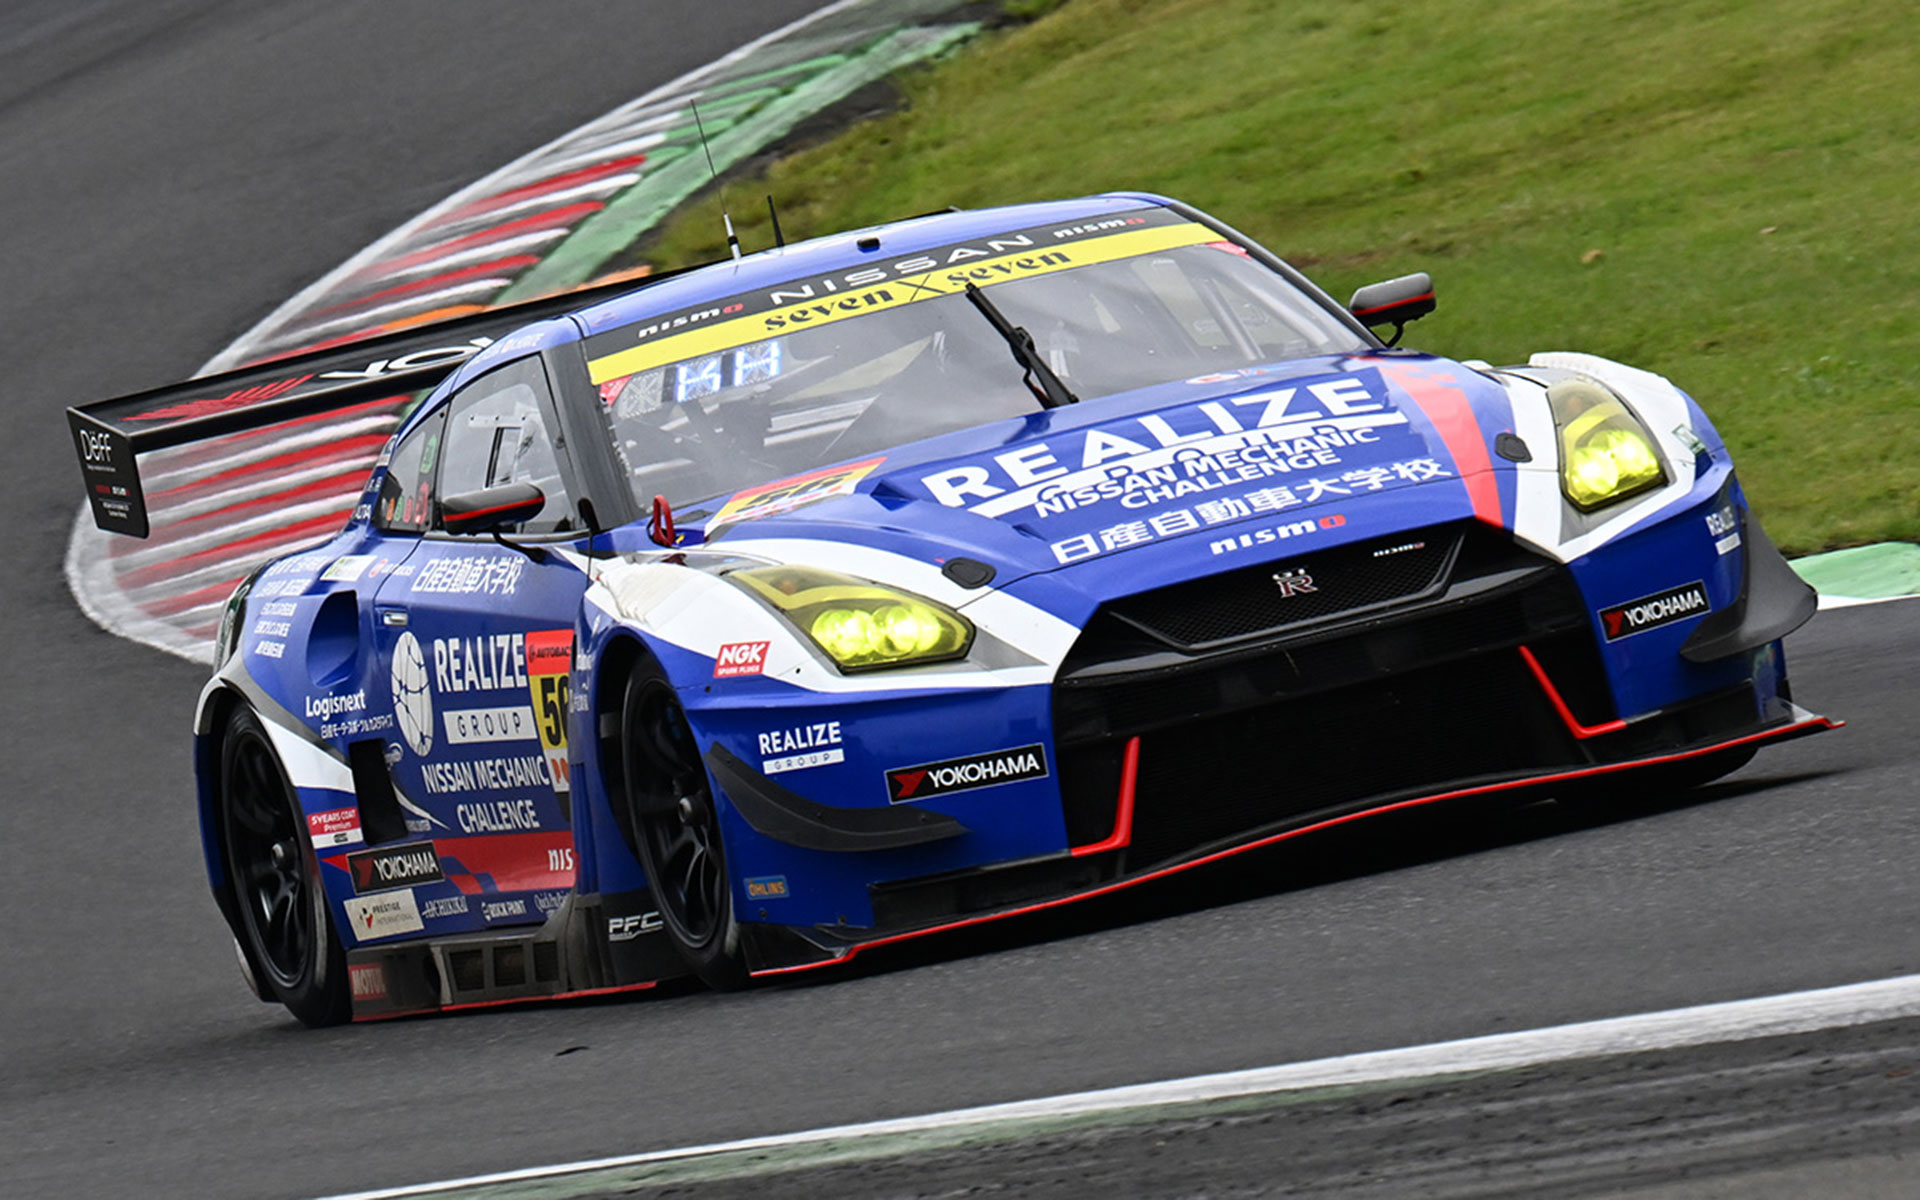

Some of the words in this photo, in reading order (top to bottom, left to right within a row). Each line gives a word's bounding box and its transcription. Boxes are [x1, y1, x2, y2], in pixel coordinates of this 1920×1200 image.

[1054, 218, 1145, 239] nismo
[770, 234, 1034, 305] NISSAN
[764, 289, 893, 331] seven
[947, 250, 1072, 286] seven
[638, 303, 743, 338] nismo
[922, 378, 1384, 508] REALIZE
[1036, 464, 1176, 518] NISSAN
[1184, 428, 1380, 483] MECHANIC
[1120, 449, 1341, 509] CHALLENGE
[1051, 458, 1452, 565] 日産自動車大学校
[1210, 514, 1346, 556] nismo
[411, 556, 525, 595] 日産自動車大学校
[1625, 590, 1704, 627] YOKOHAMA
[434, 633, 527, 693] REALIZE
[719, 643, 766, 666] NGK
[306, 689, 366, 721] Logisnext
[457, 711, 522, 738] GROUP
[758, 721, 842, 755] REALIZE
[421, 764, 474, 794] NISSAN
[476, 756, 550, 789] MECHANIC
[774, 752, 832, 771] GROUP
[928, 753, 1040, 788] YOKOHAMA
[456, 800, 541, 833] CHALLENGE
[374, 851, 439, 881] YOKOHAMA
[609, 911, 664, 933] PFC
